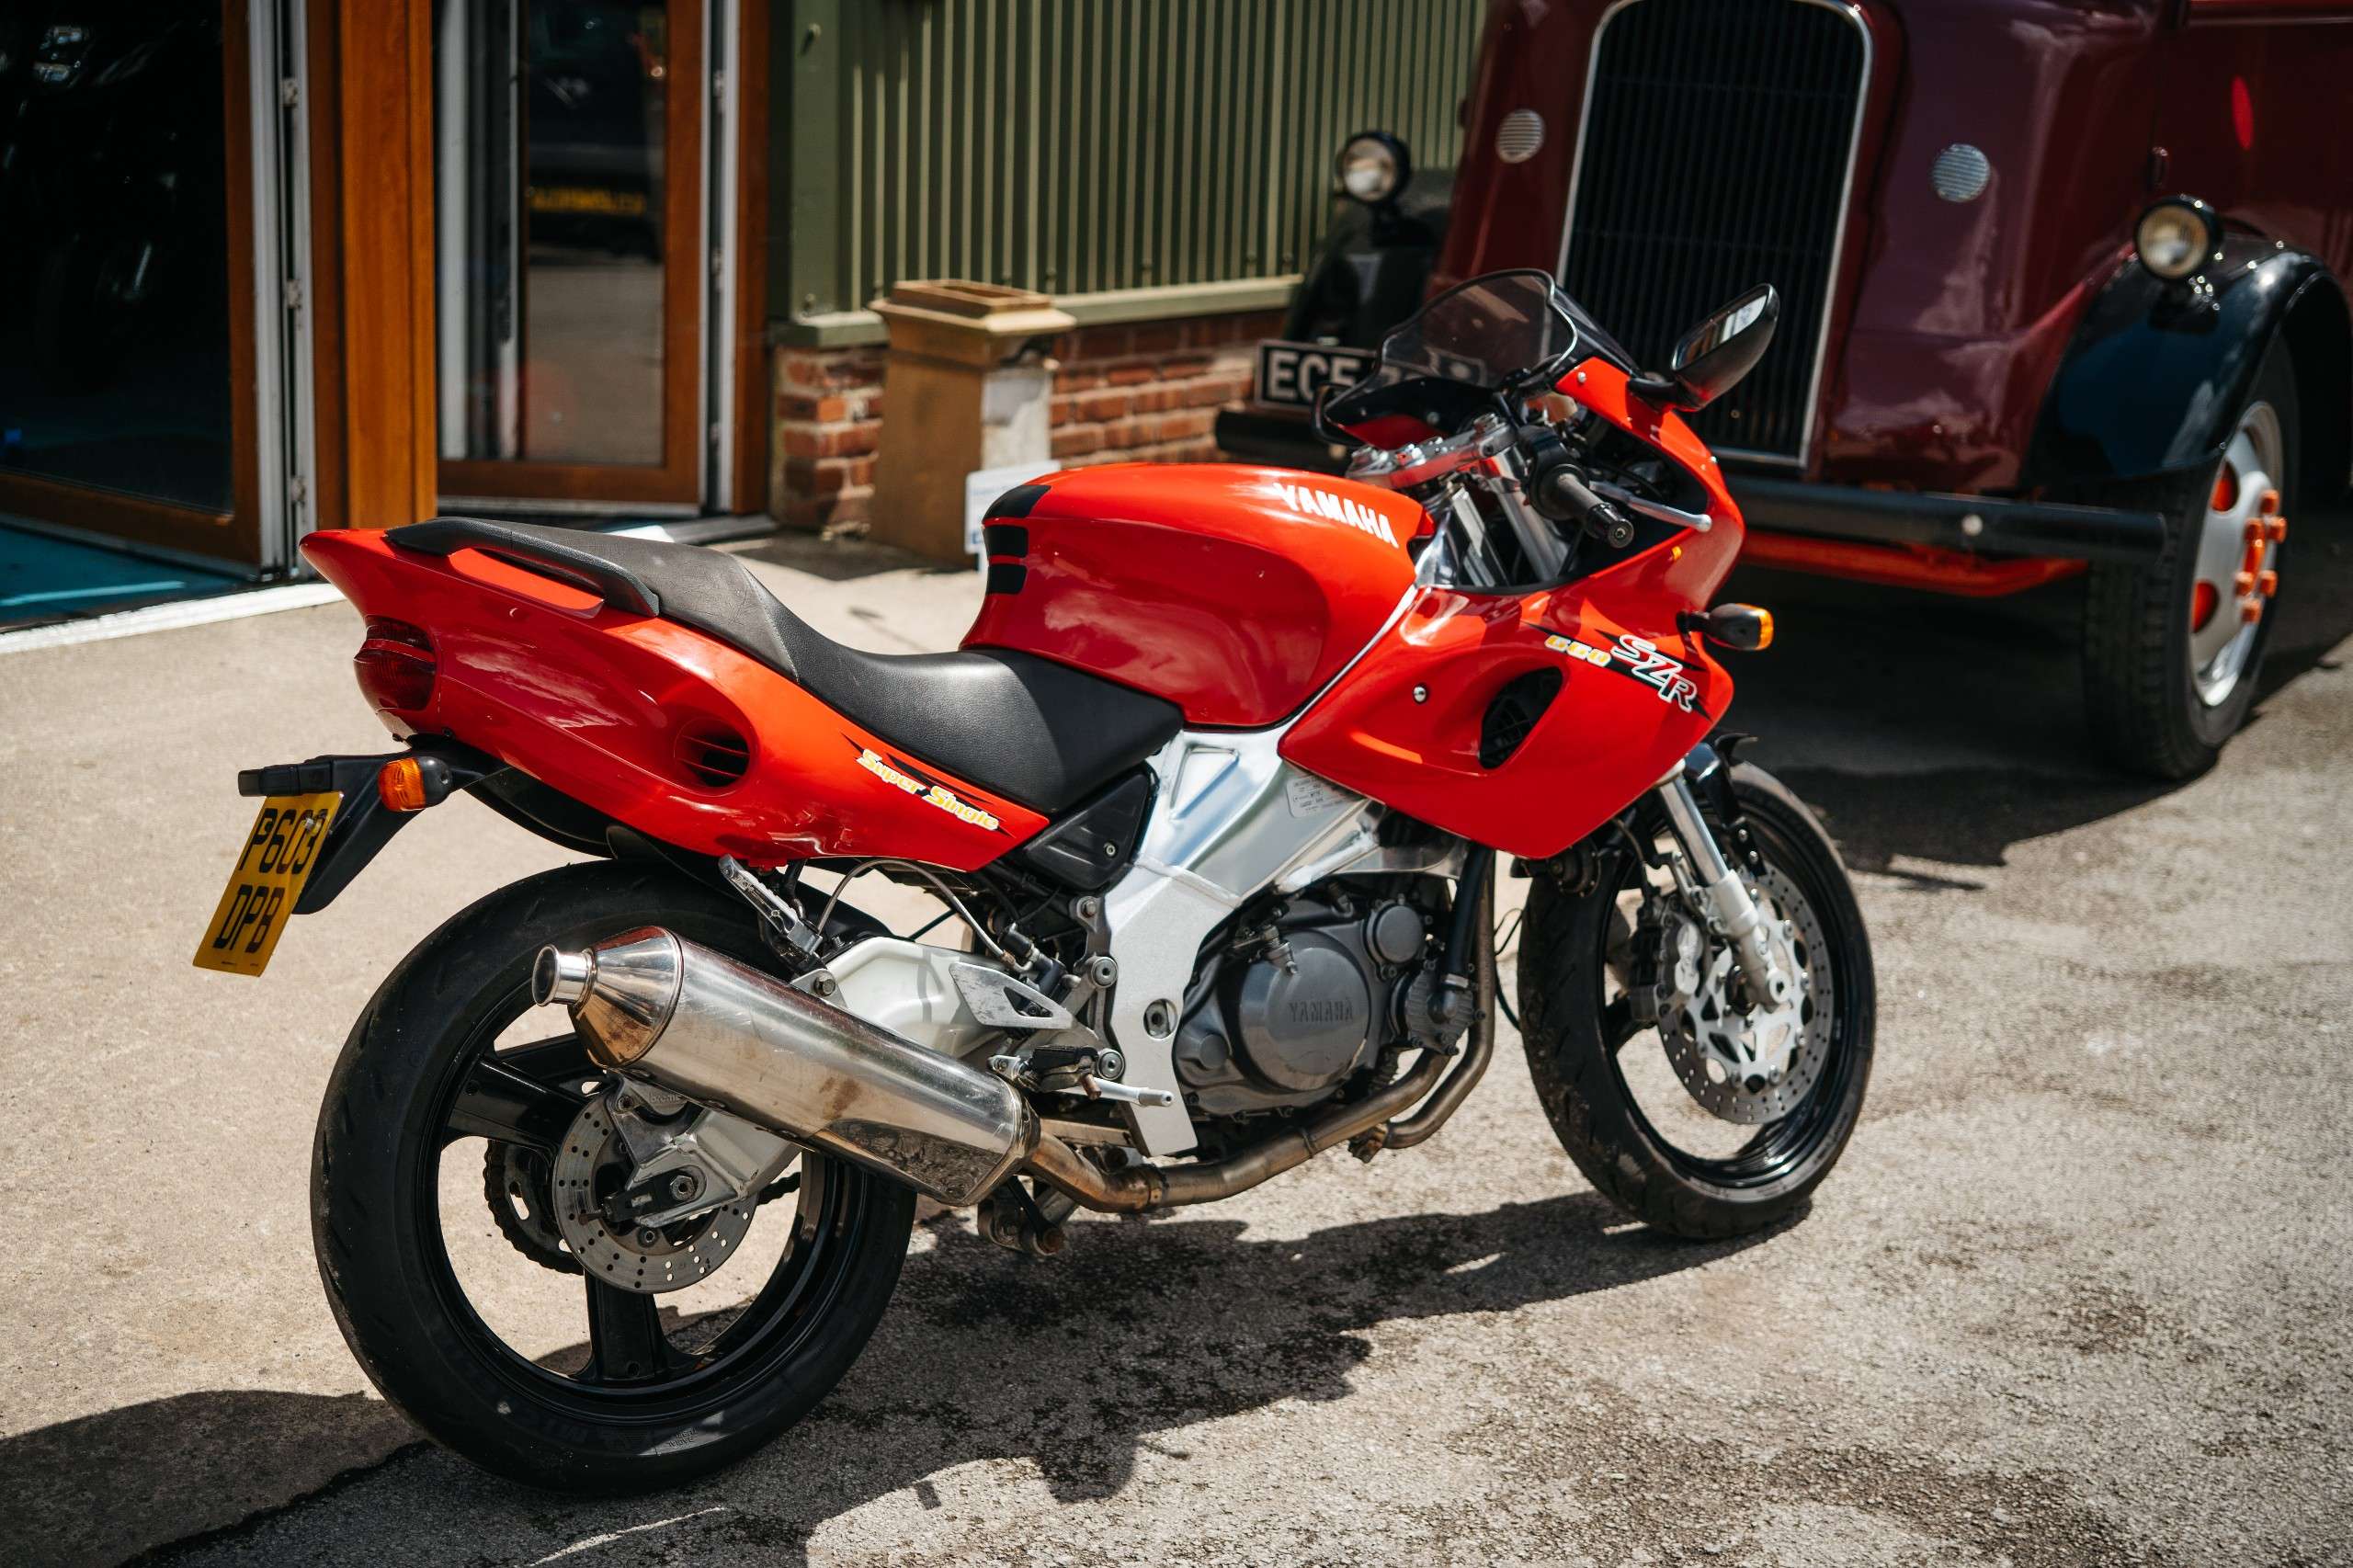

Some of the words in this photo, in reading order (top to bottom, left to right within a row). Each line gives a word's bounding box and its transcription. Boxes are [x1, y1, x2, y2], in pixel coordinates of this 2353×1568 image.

[1273, 483, 1399, 549] YAMAHA
[1610, 634, 1698, 713] SZR
[857, 749, 926, 795] Super
[922, 786, 999, 831] Single
[238, 808, 329, 875] P603
[212, 883, 285, 954] DPB
[1288, 1000, 1354, 1023] YAMAHA
